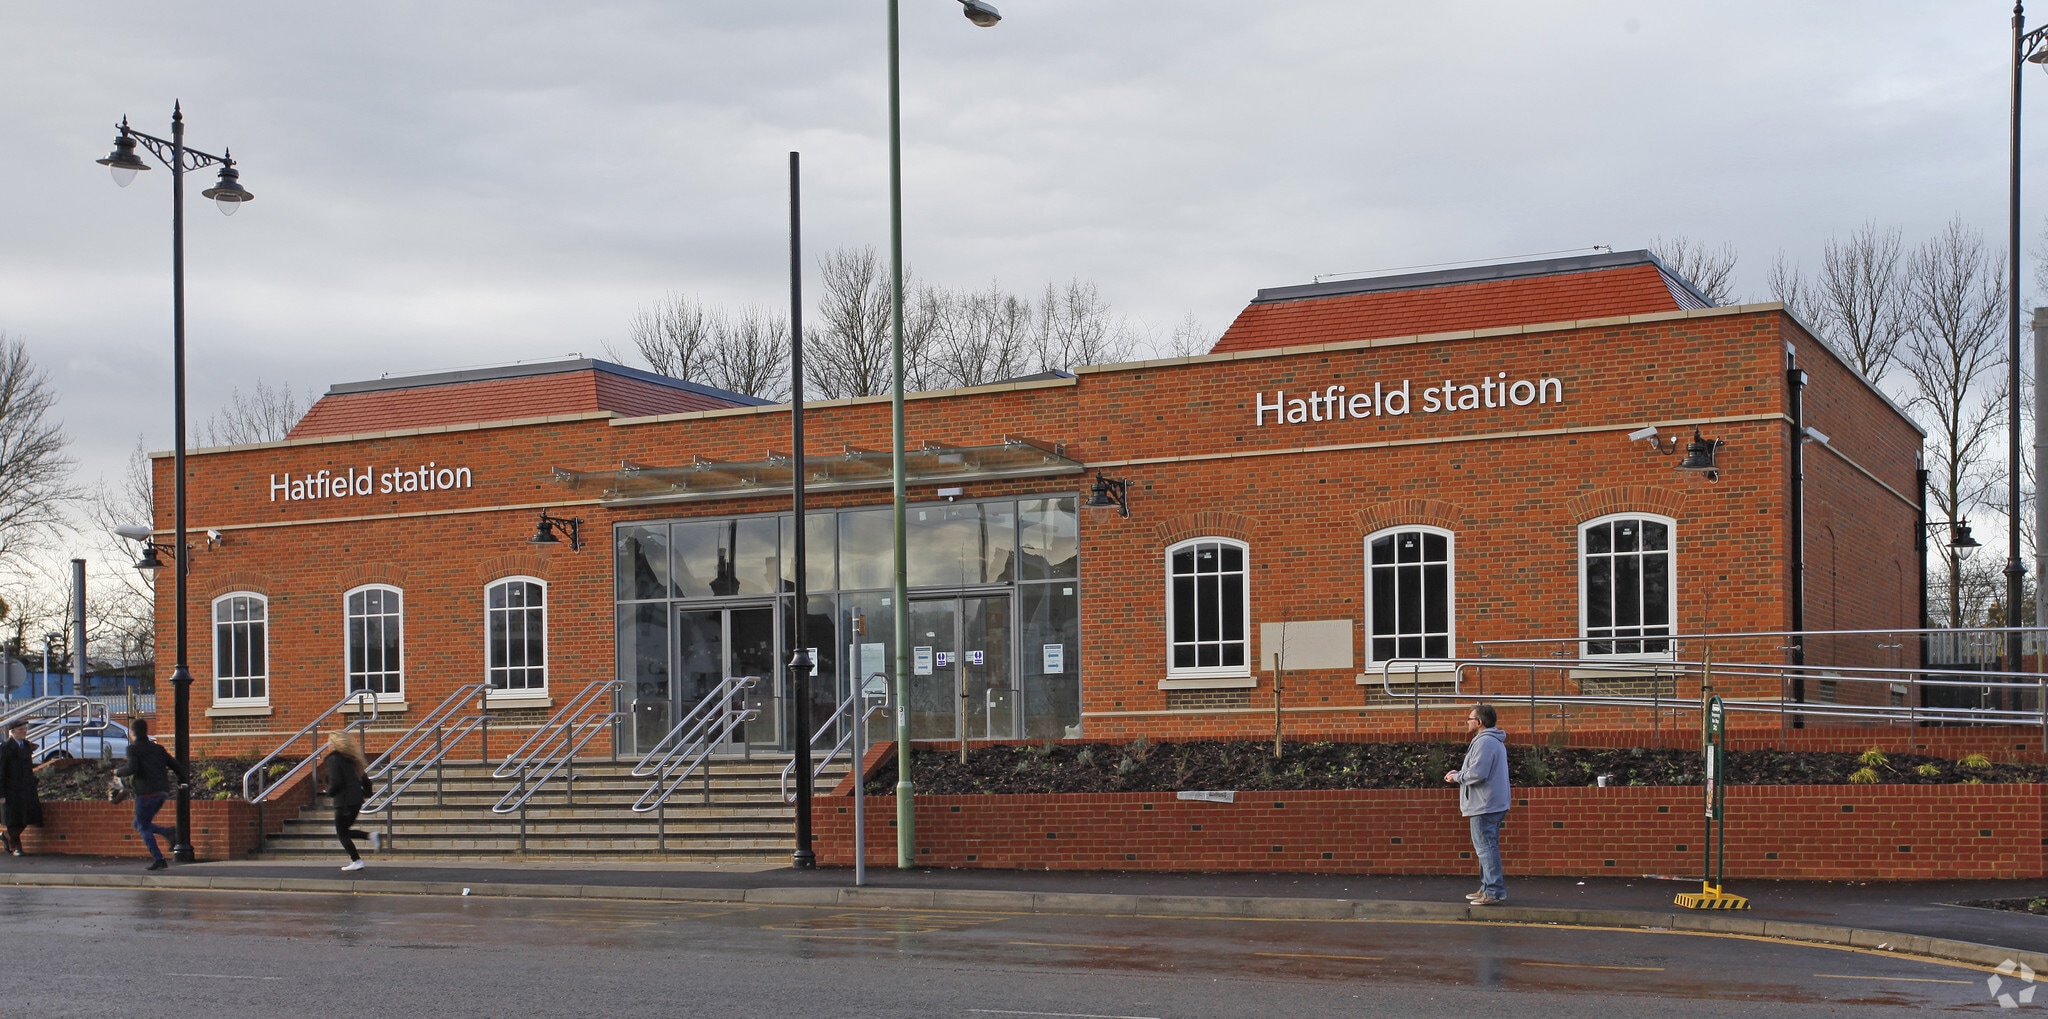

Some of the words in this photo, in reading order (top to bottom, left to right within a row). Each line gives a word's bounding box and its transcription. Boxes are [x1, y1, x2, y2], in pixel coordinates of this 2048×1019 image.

[1256, 379, 1410, 426] Hatfield
[1422, 371, 1562, 413] station
[270, 466, 373, 502] Hatfield
[380, 461, 472, 494] station
